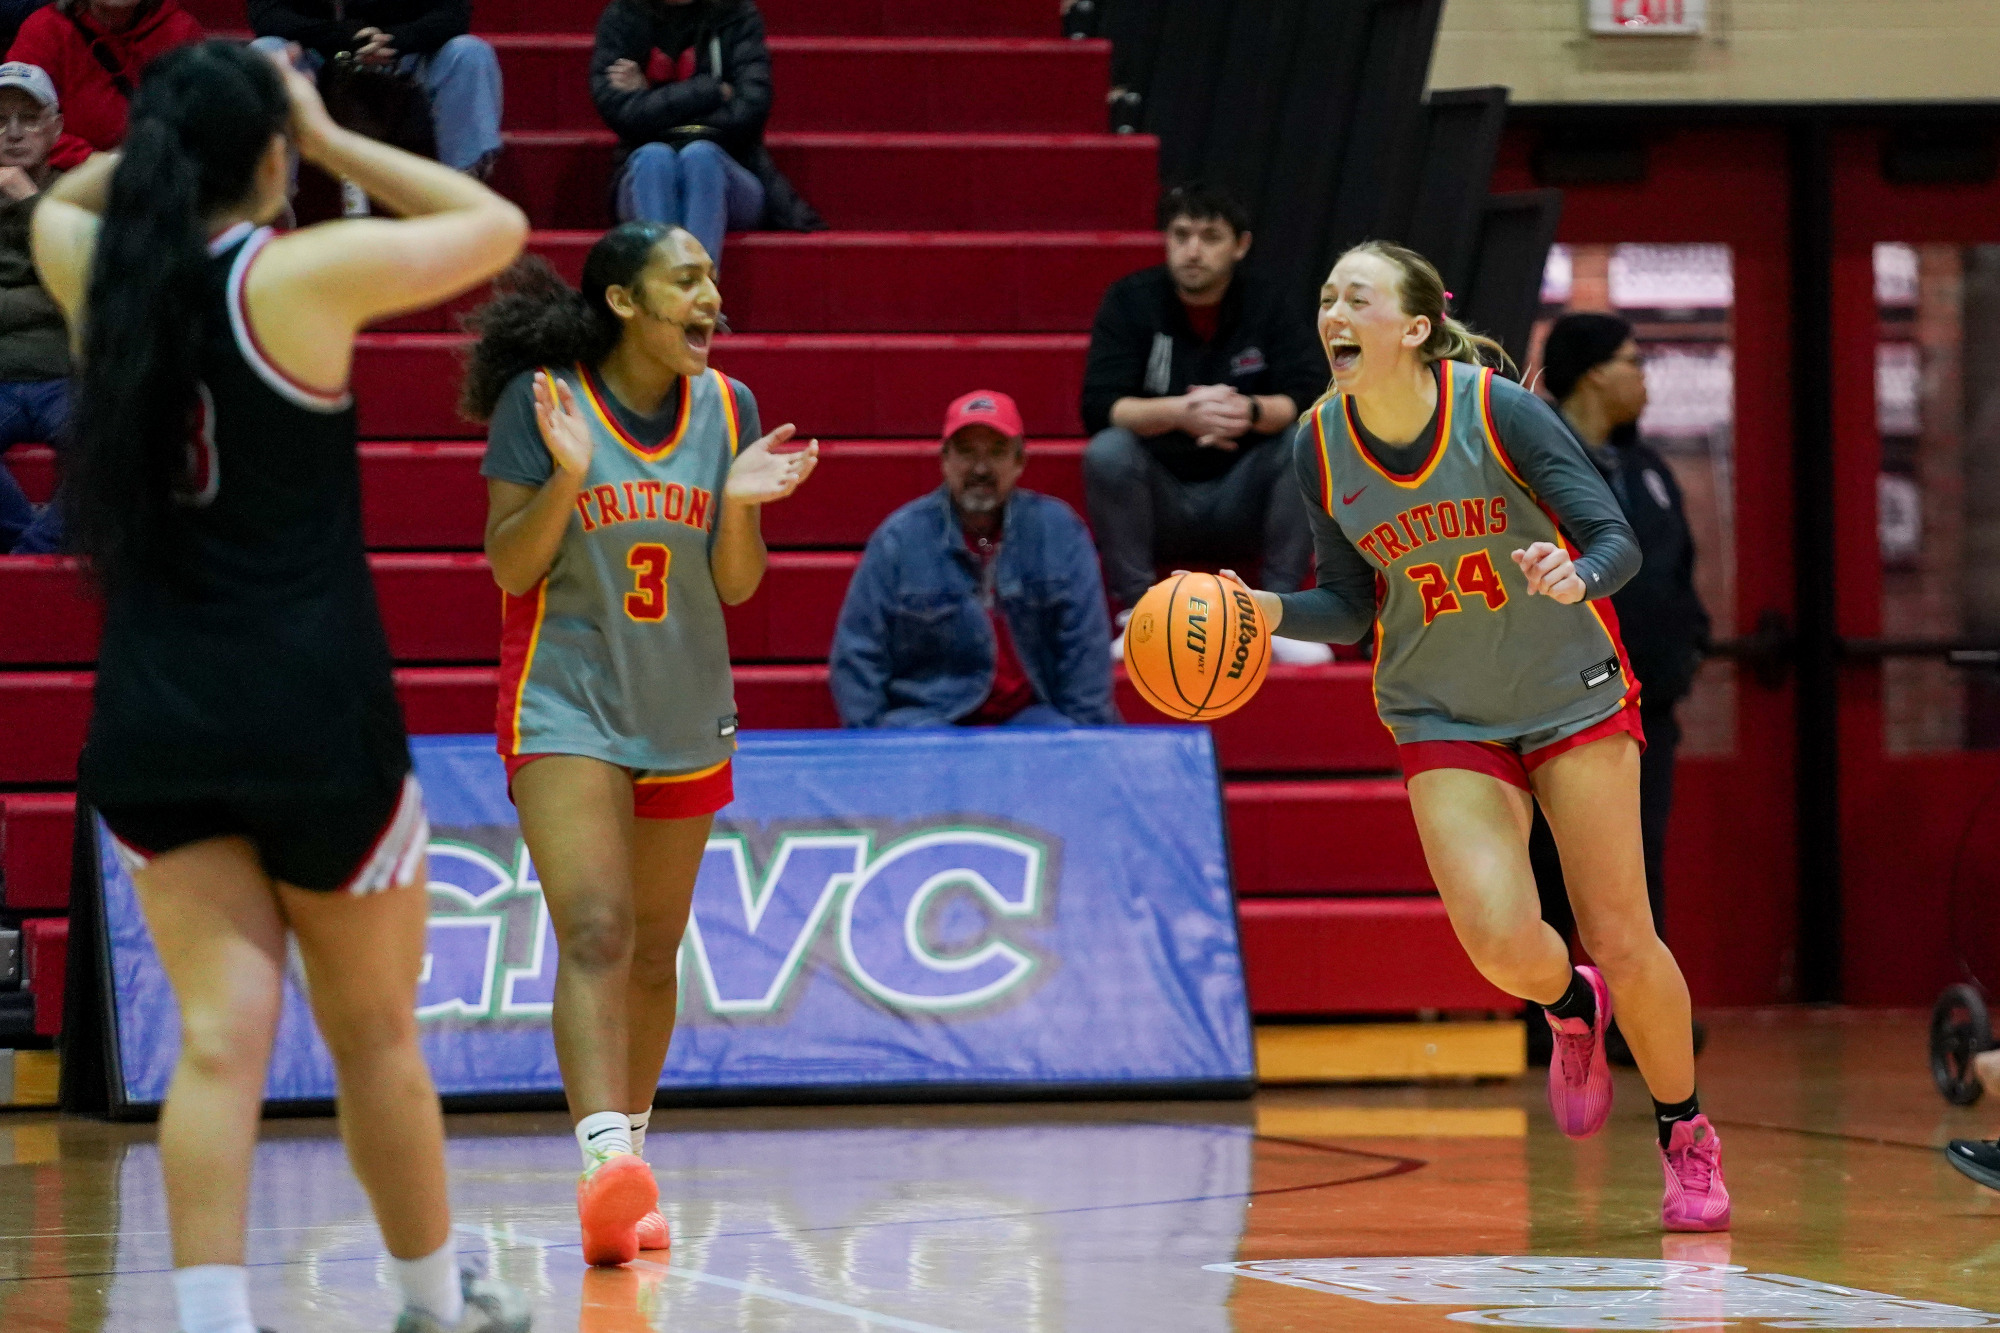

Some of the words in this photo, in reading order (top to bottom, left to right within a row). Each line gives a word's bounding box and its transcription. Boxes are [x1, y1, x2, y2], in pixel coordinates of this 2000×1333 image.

[1357, 496, 1508, 567] TRITONS
[623, 542, 671, 623] 3
[1404, 548, 1509, 626] 24
[1188, 596, 1208, 655] EVO
[1227, 590, 1258, 679] Wilson
